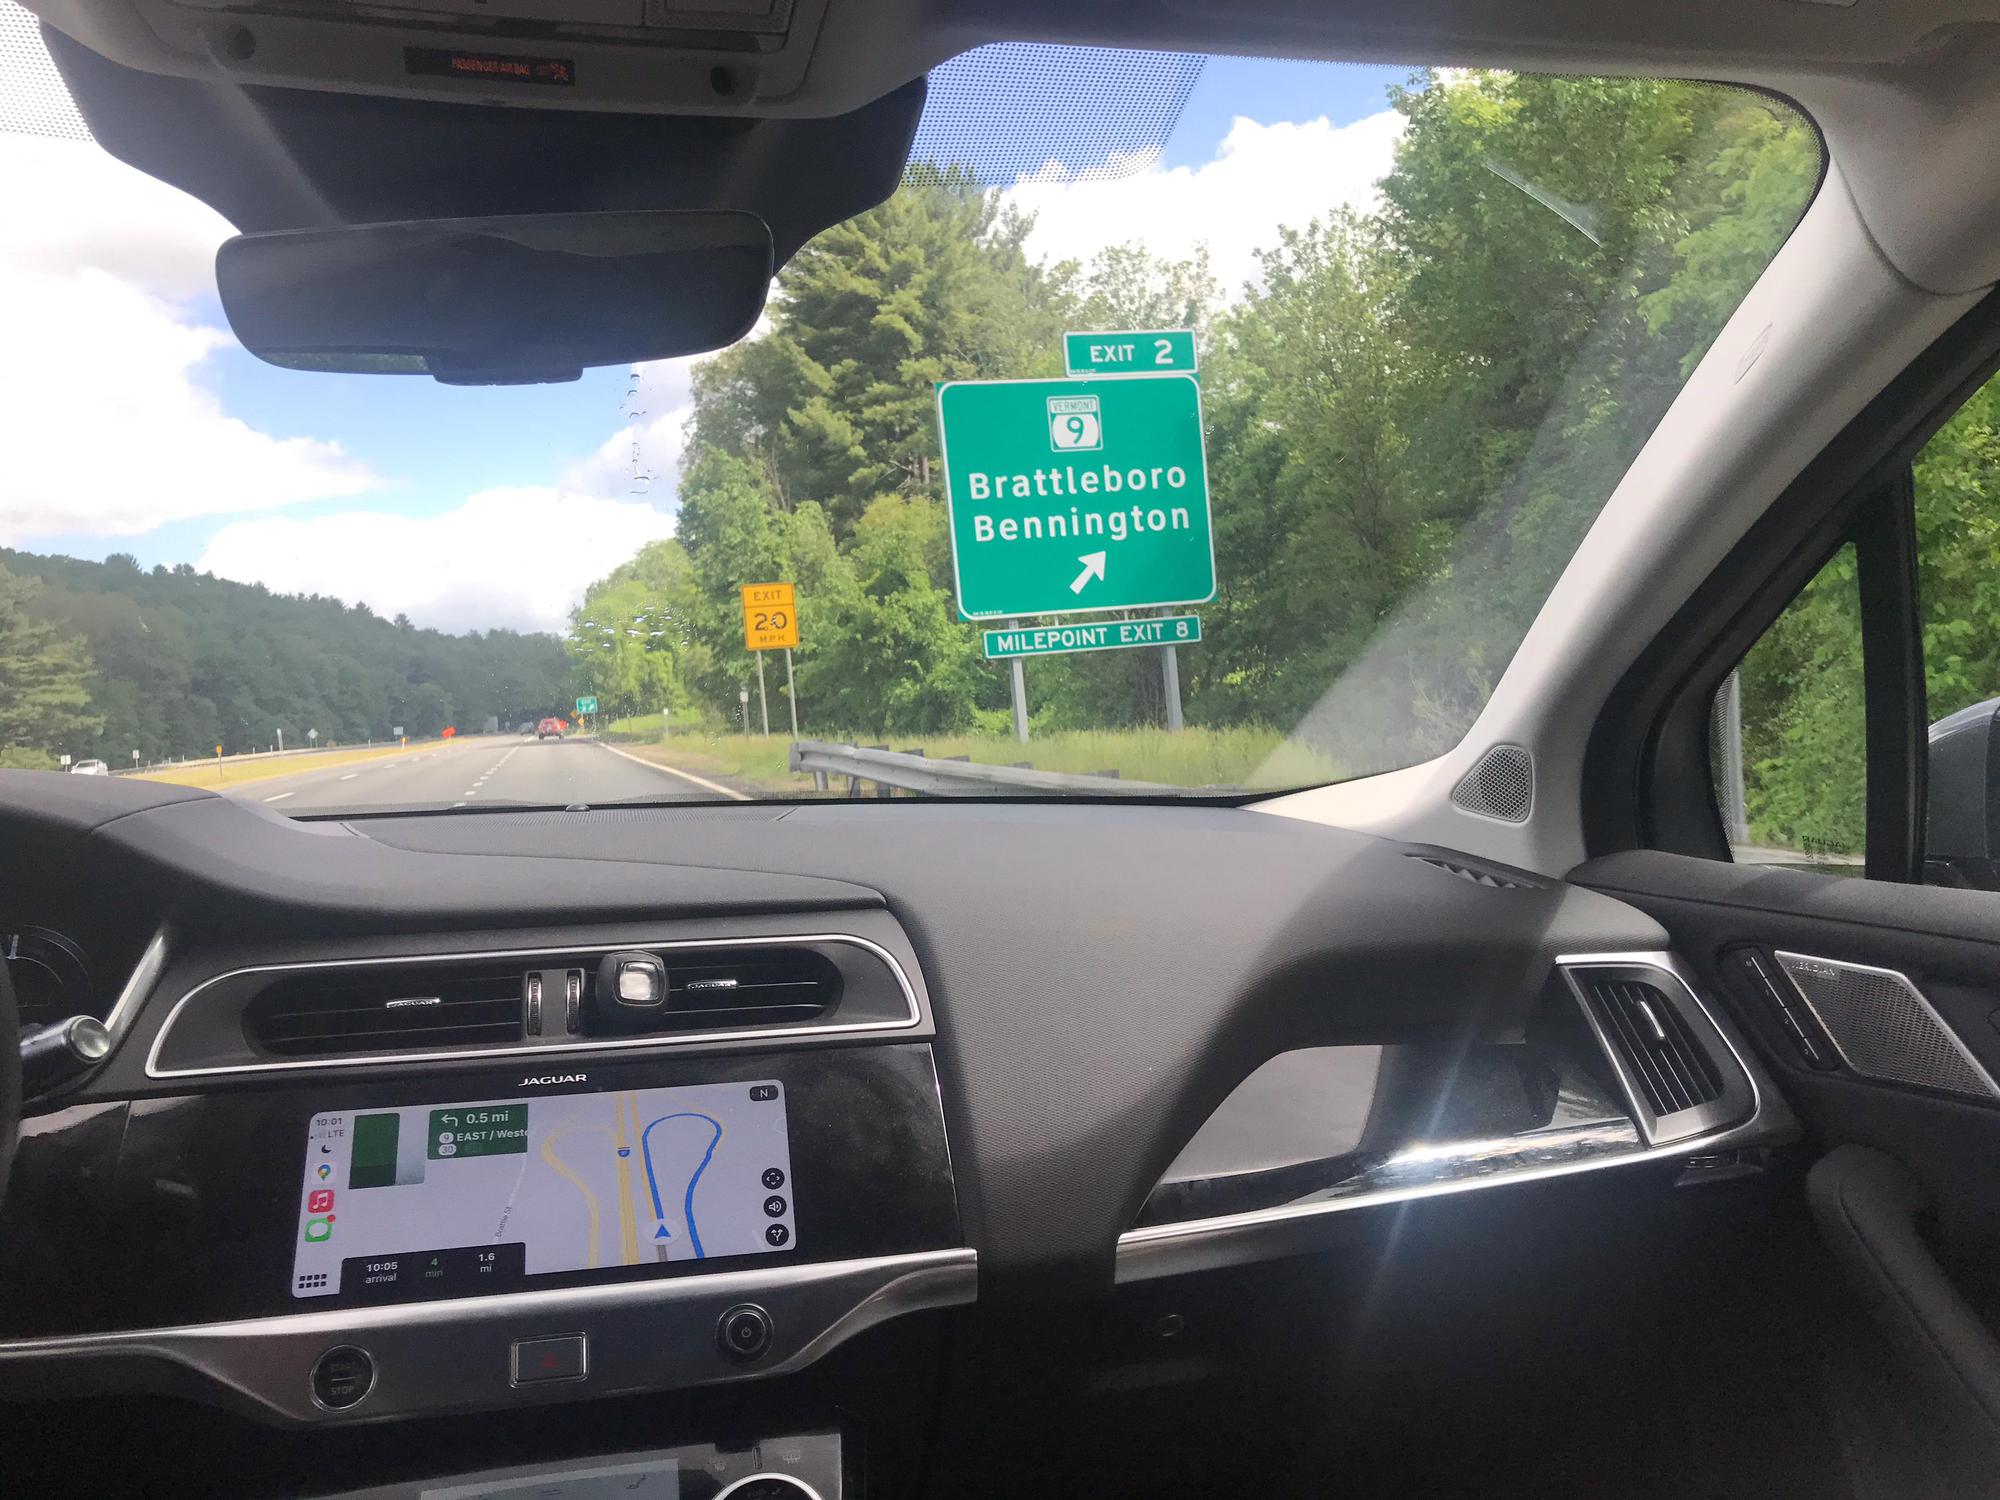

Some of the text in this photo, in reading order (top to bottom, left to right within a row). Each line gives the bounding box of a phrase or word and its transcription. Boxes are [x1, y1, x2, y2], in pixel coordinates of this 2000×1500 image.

[1089, 339, 1174, 364] EXIT 2
[1052, 399, 1096, 413] VERMONT
[1066, 416, 1084, 444] 9
[968, 465, 1187, 500] Brattleboro
[973, 505, 1190, 542] Bennington
[753, 590, 782, 601] EXIT
[754, 611, 788, 631] 20
[997, 621, 1189, 653] MILEPOINT EXIT 8
[518, 1074, 588, 1087] JAGUAR
[760, 1088, 768, 1098] N
[316, 1117, 342, 1126] 10:01
[466, 1110, 509, 1124] 0.5 mi
[328, 1129, 345, 1138] LTE
[457, 1131, 486, 1142] EAST
[431, 1258, 438, 1266] 4
[478, 1252, 495, 1262] 1.6
[366, 1261, 398, 1272] 10:05
[480, 1263, 492, 1273] mi
[365, 1273, 397, 1284] arrival
[425, 1269, 443, 1277] min
[331, 1386, 354, 1395] STOP
